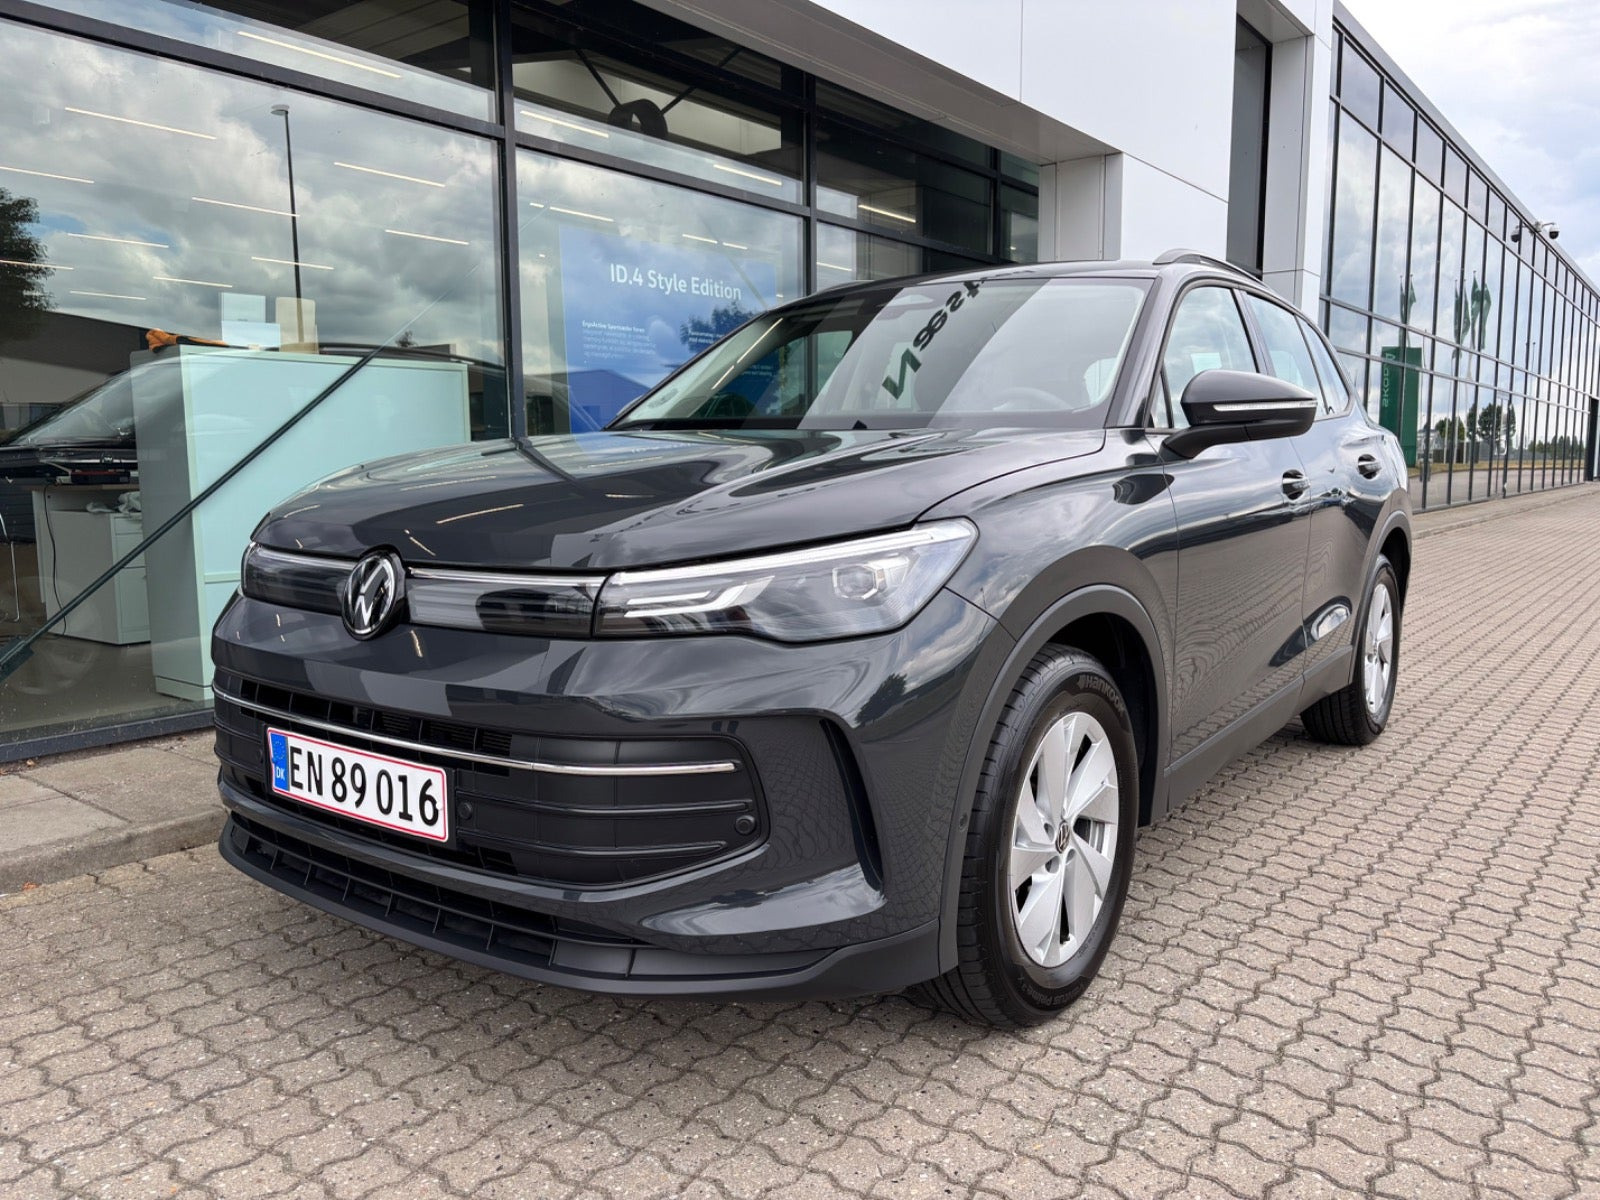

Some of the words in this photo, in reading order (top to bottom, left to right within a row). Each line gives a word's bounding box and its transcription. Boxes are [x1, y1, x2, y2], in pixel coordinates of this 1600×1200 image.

[610, 263, 643, 287] ID.4
[647, 269, 688, 295] Style
[691, 276, 742, 301] Edition
[275, 766, 286, 781] DK
